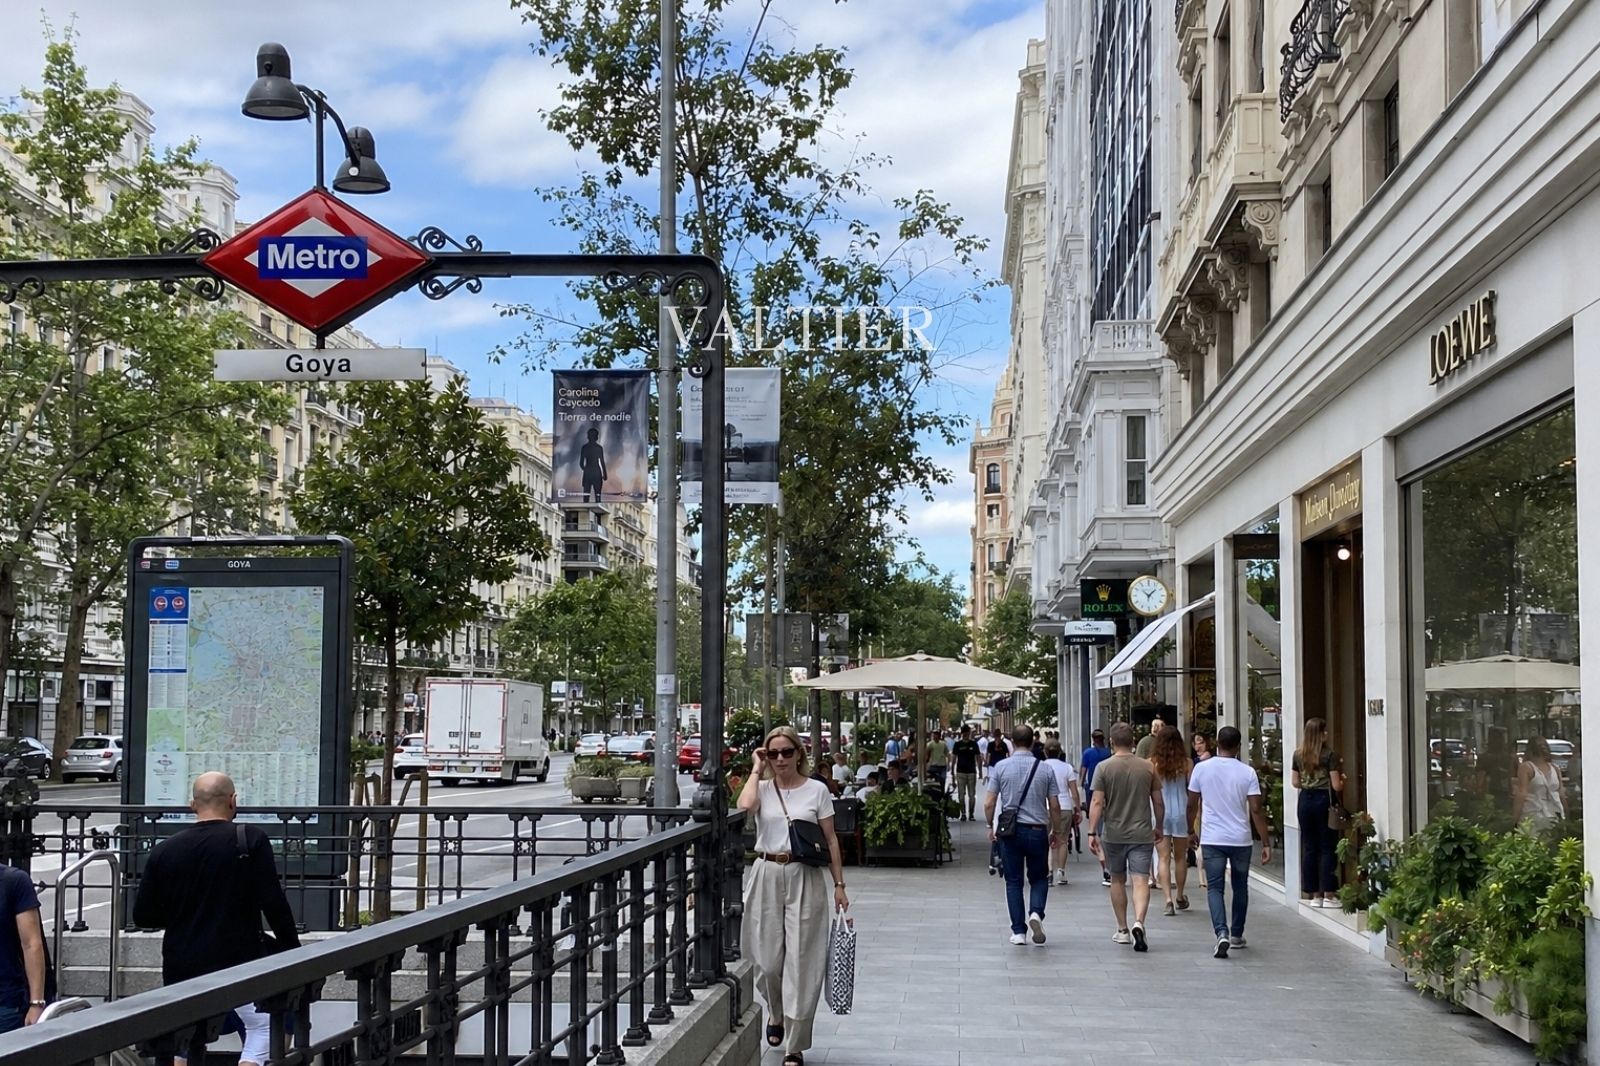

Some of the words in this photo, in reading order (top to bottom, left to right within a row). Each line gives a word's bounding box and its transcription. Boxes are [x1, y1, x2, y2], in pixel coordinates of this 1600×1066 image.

[267, 243, 360, 270] Metro
[1428, 290, 1497, 386] LOEWE
[285, 353, 351, 377] Goya
[558, 387, 599, 398] Carolina
[558, 398, 601, 409] Caycedo
[589, 412, 602, 422] de
[227, 560, 251, 569] GOYA
[1083, 603, 1124, 613] ROLEX
